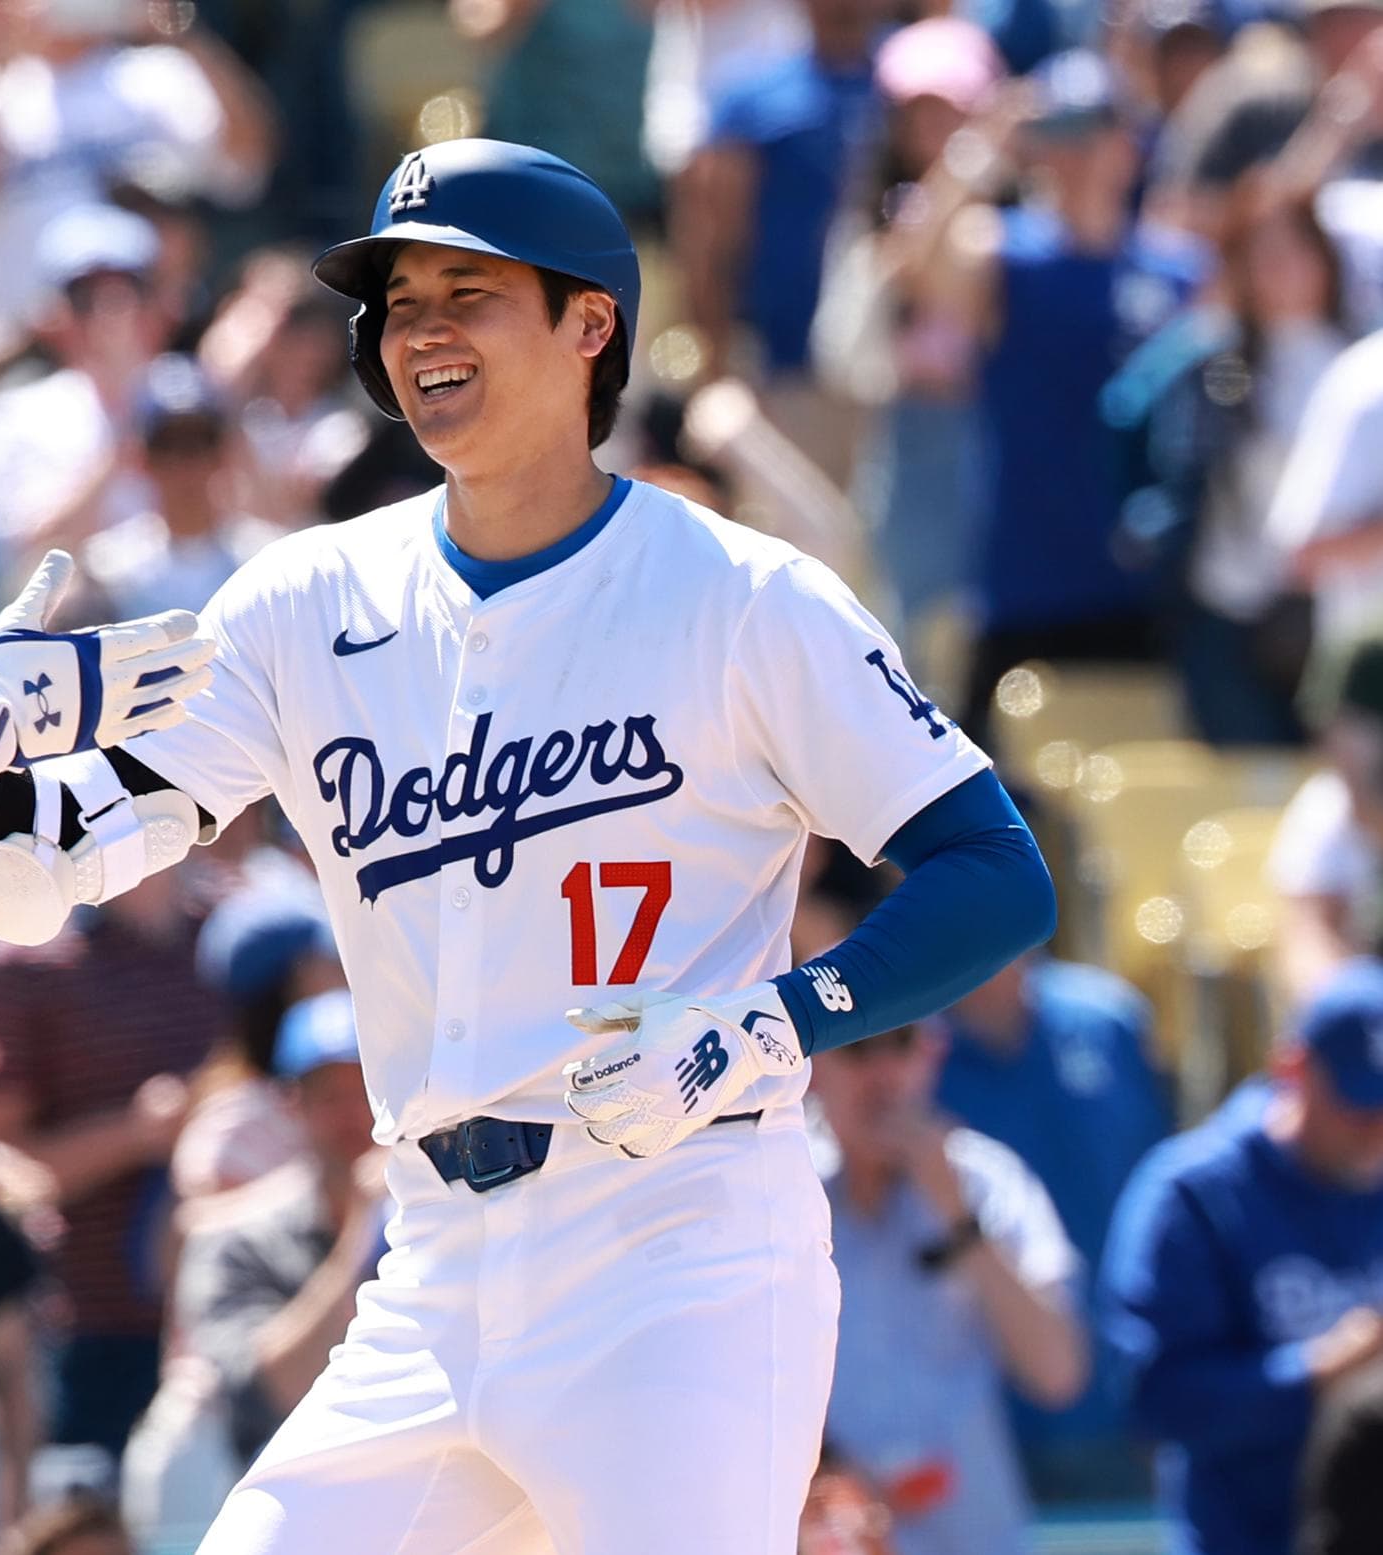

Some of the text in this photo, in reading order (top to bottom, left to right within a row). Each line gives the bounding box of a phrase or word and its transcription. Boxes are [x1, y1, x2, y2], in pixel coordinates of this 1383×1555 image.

[388, 152, 433, 214] LA
[314, 712, 684, 890] Dodgers
[561, 861, 672, 986] 17
[578, 1053, 642, 1085] new balance
